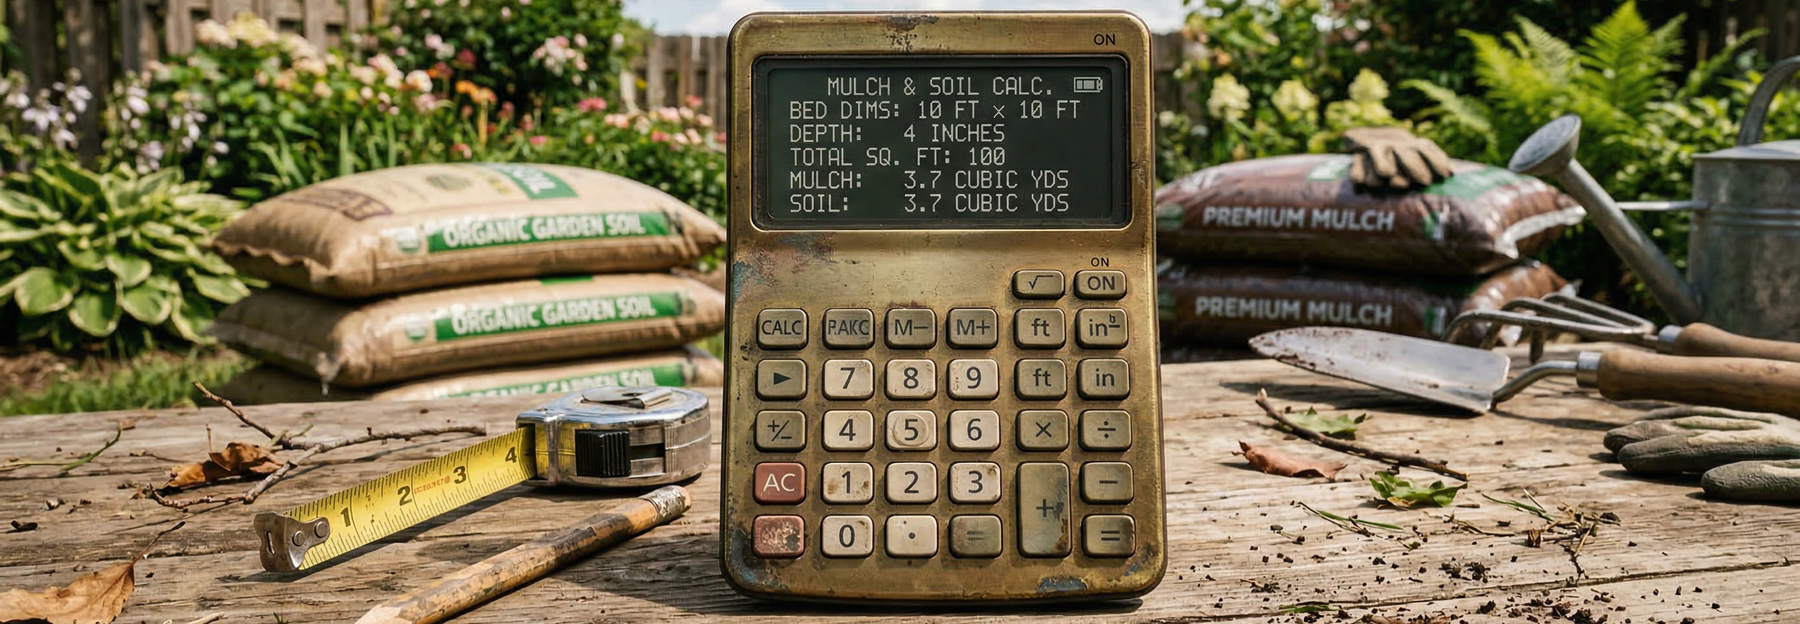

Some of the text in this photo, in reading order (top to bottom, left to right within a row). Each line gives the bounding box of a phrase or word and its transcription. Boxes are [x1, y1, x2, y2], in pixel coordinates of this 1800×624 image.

[1093, 33, 1116, 46] ON
[827, 77, 1053, 96] MULCH & SOIL CALC.
[790, 101, 827, 120] BED
[841, 101, 900, 120] DIMS:
[918, 101, 942, 119] 10
[955, 100, 980, 119] FT
[1020, 100, 1043, 119] 10
[1056, 100, 1081, 119] FT
[790, 124, 1005, 143] DEPTH: 4 INCHES
[790, 147, 1005, 167] TOTAL SQ. FT: 100
[790, 170, 1069, 190] MULCH: 3.7 CUBIC YDS
[790, 194, 1069, 213] SOIL: 3.7 CUBIC YDS
[1202, 206, 1396, 232] PREMIUM MULCH
[442, 212, 647, 248] ORGANIC GARDEN SOIL
[1090, 257, 1110, 268] ON
[1087, 275, 1116, 291] ON
[450, 296, 657, 335] ORGANIC GARDEN SOIL
[1194, 296, 1393, 325] PREMIUM MULCH
[761, 319, 802, 336] CALC
[956, 319, 991, 336] M+
[1031, 317, 1050, 337] ft
[840, 366, 856, 390] 7
[903, 366, 919, 390] 8
[966, 366, 982, 390] 9
[1032, 367, 1052, 387] ft
[1095, 368, 1115, 387] in
[838, 418, 857, 442] 4
[904, 418, 919, 442] 5
[966, 418, 983, 442] 6
[505, 446, 518, 464] 4
[453, 465, 467, 485] 3
[762, 473, 797, 493] AC
[841, 470, 852, 494] 1
[903, 470, 920, 494] 2
[967, 470, 983, 494] 3
[397, 485, 413, 506] 2
[340, 507, 352, 528] 1
[838, 524, 856, 548] 0
